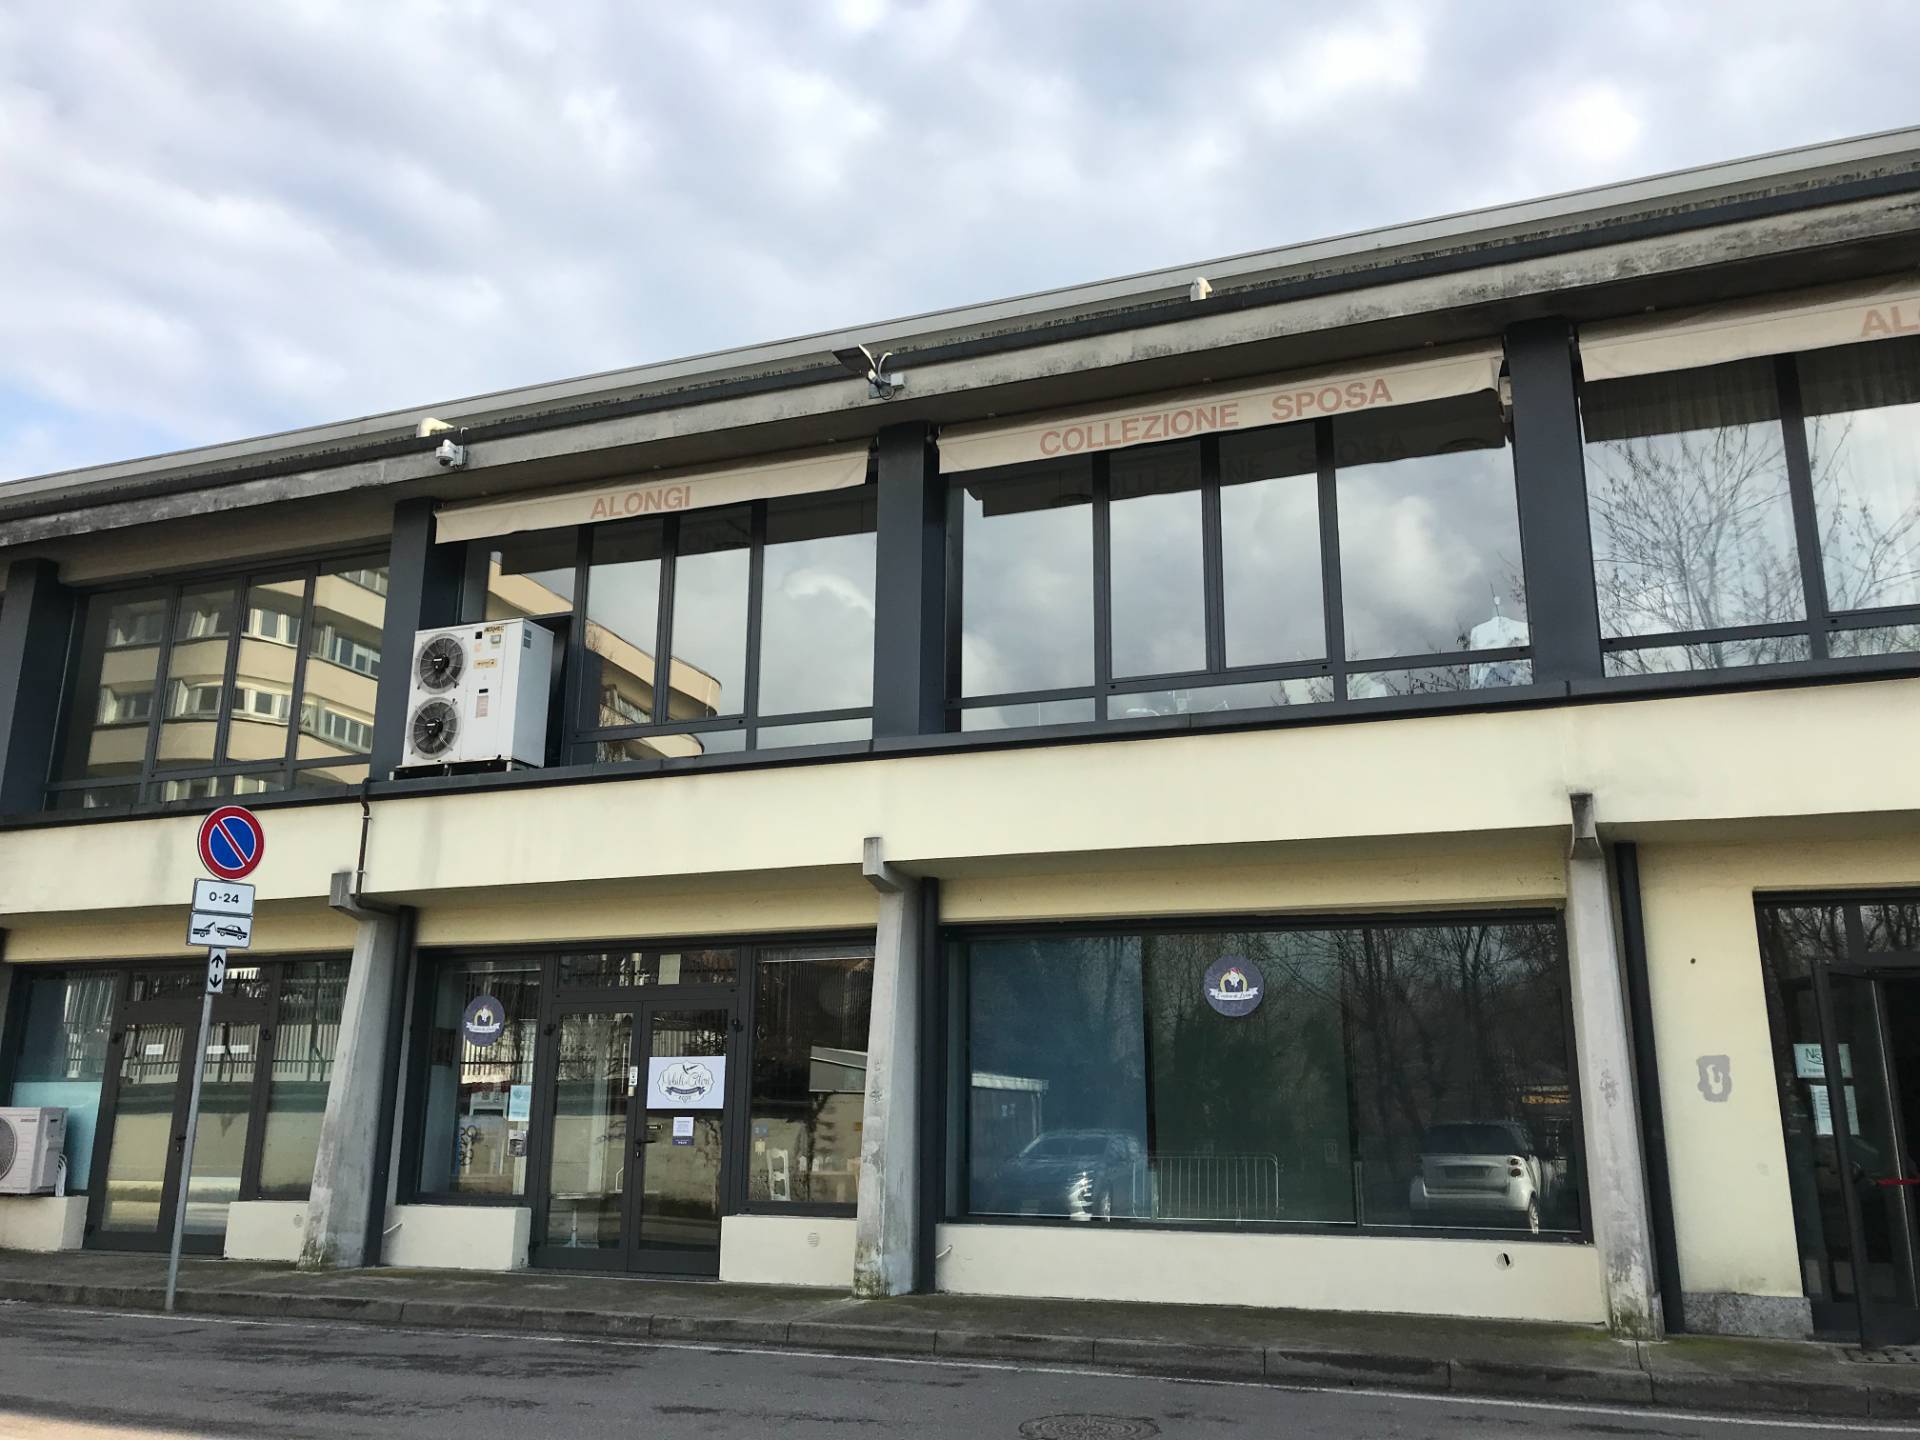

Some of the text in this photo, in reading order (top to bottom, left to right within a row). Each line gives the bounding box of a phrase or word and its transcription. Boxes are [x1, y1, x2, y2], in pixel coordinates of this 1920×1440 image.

[1861, 306, 1920, 337] AL
[1040, 403, 1239, 456] COLLEZIONE
[1271, 378, 1394, 422] SPOSA
[590, 486, 691, 519] ALONGI
[209, 891, 239, 904] 0-24
